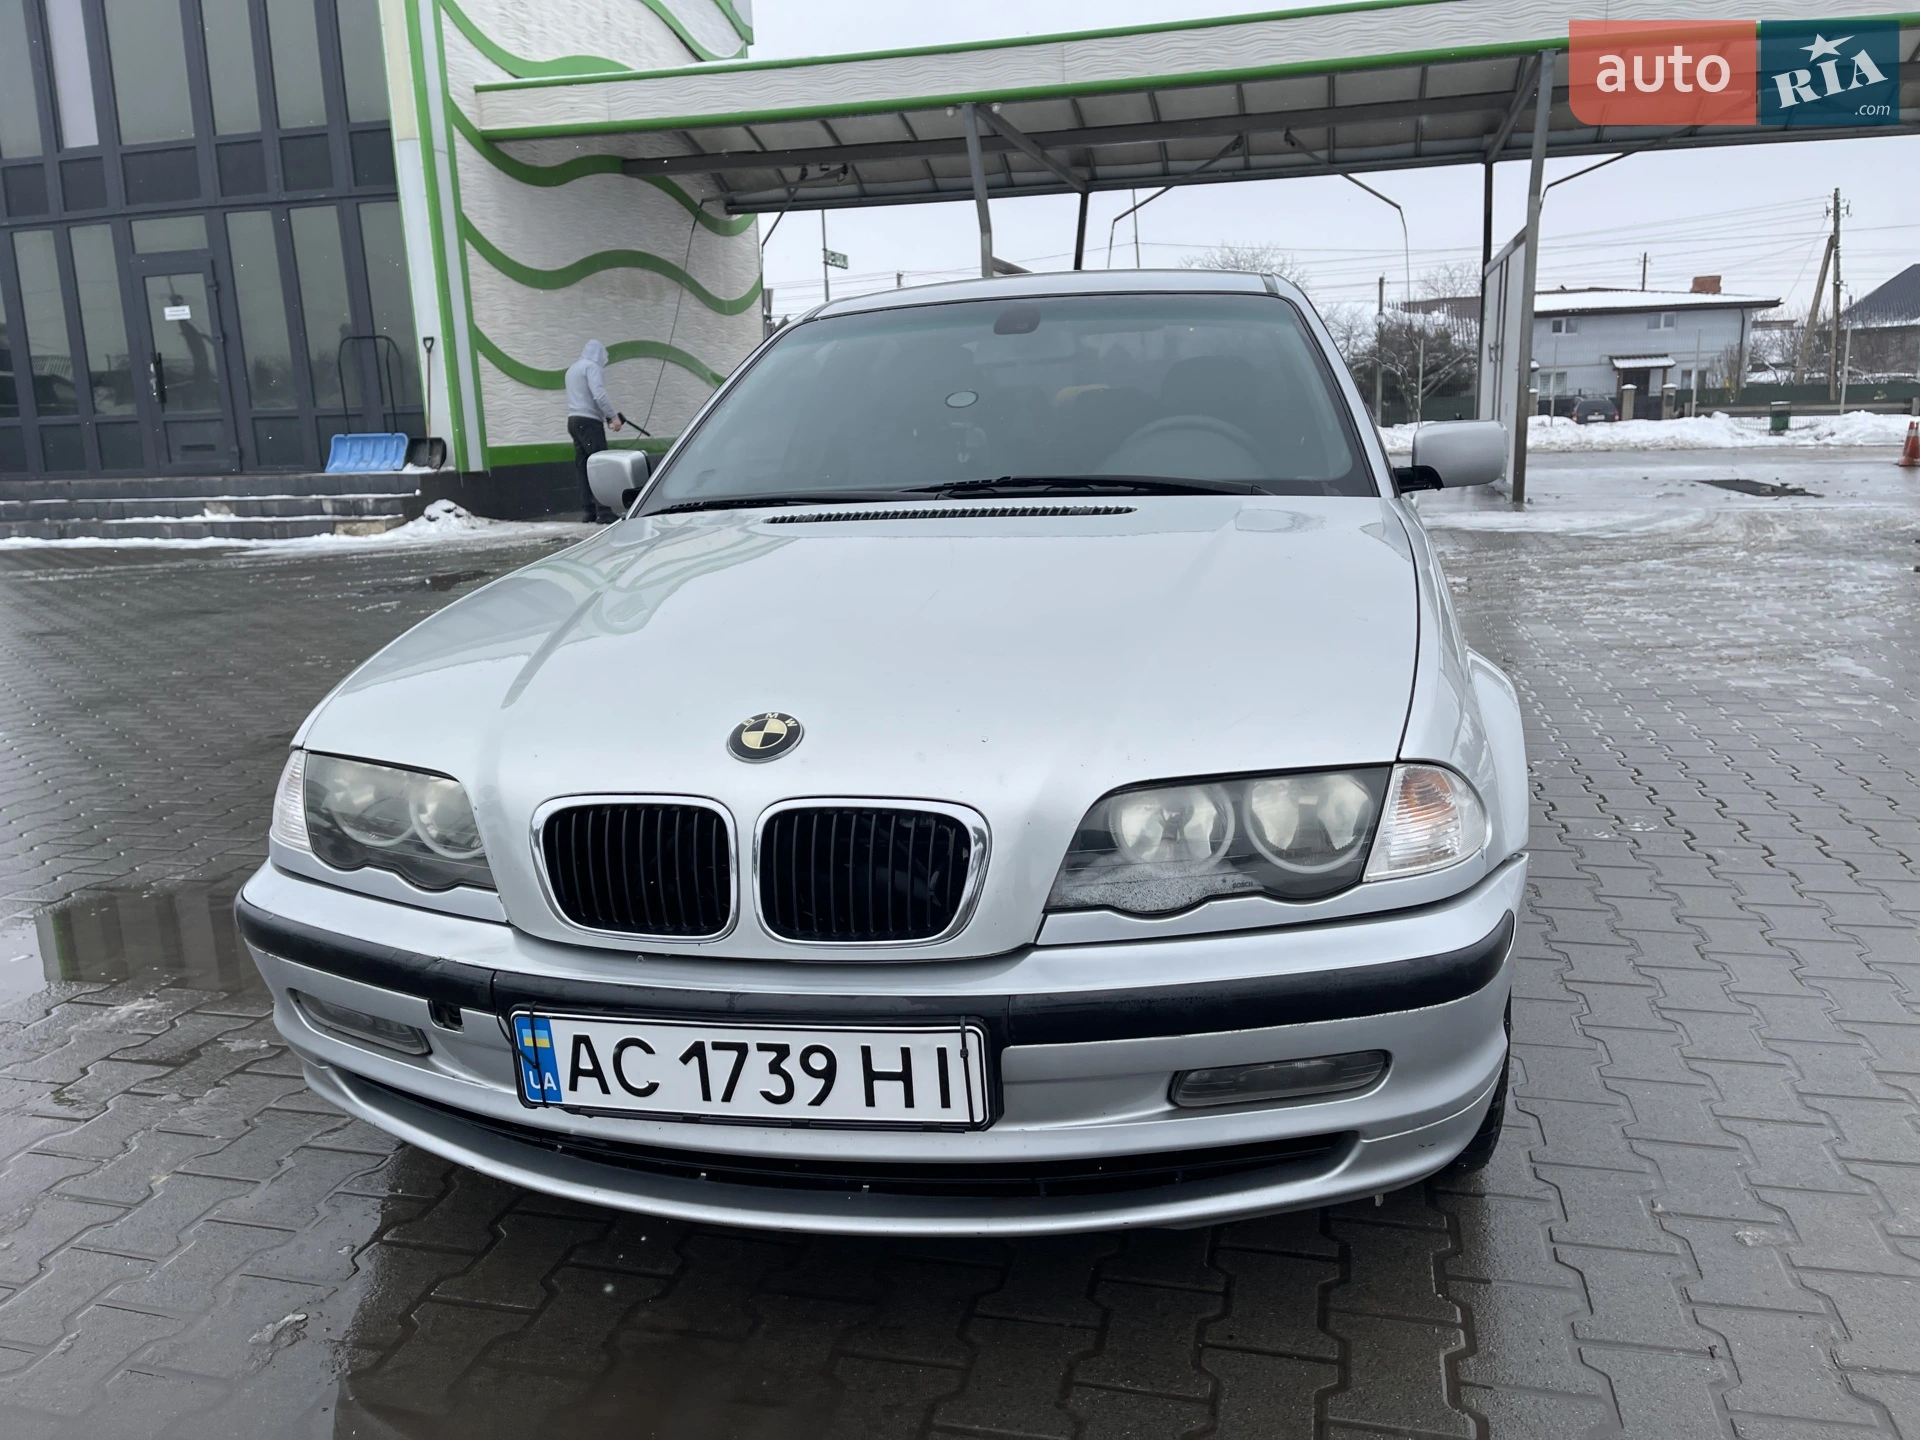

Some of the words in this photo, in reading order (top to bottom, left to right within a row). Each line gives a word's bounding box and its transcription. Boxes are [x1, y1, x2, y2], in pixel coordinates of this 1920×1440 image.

[741, 712, 798, 727] BMW
[528, 1070, 558, 1091] UA
[568, 1034, 661, 1098] AC
[678, 1040, 838, 1107] 1739
[860, 1045, 951, 1109] HI
